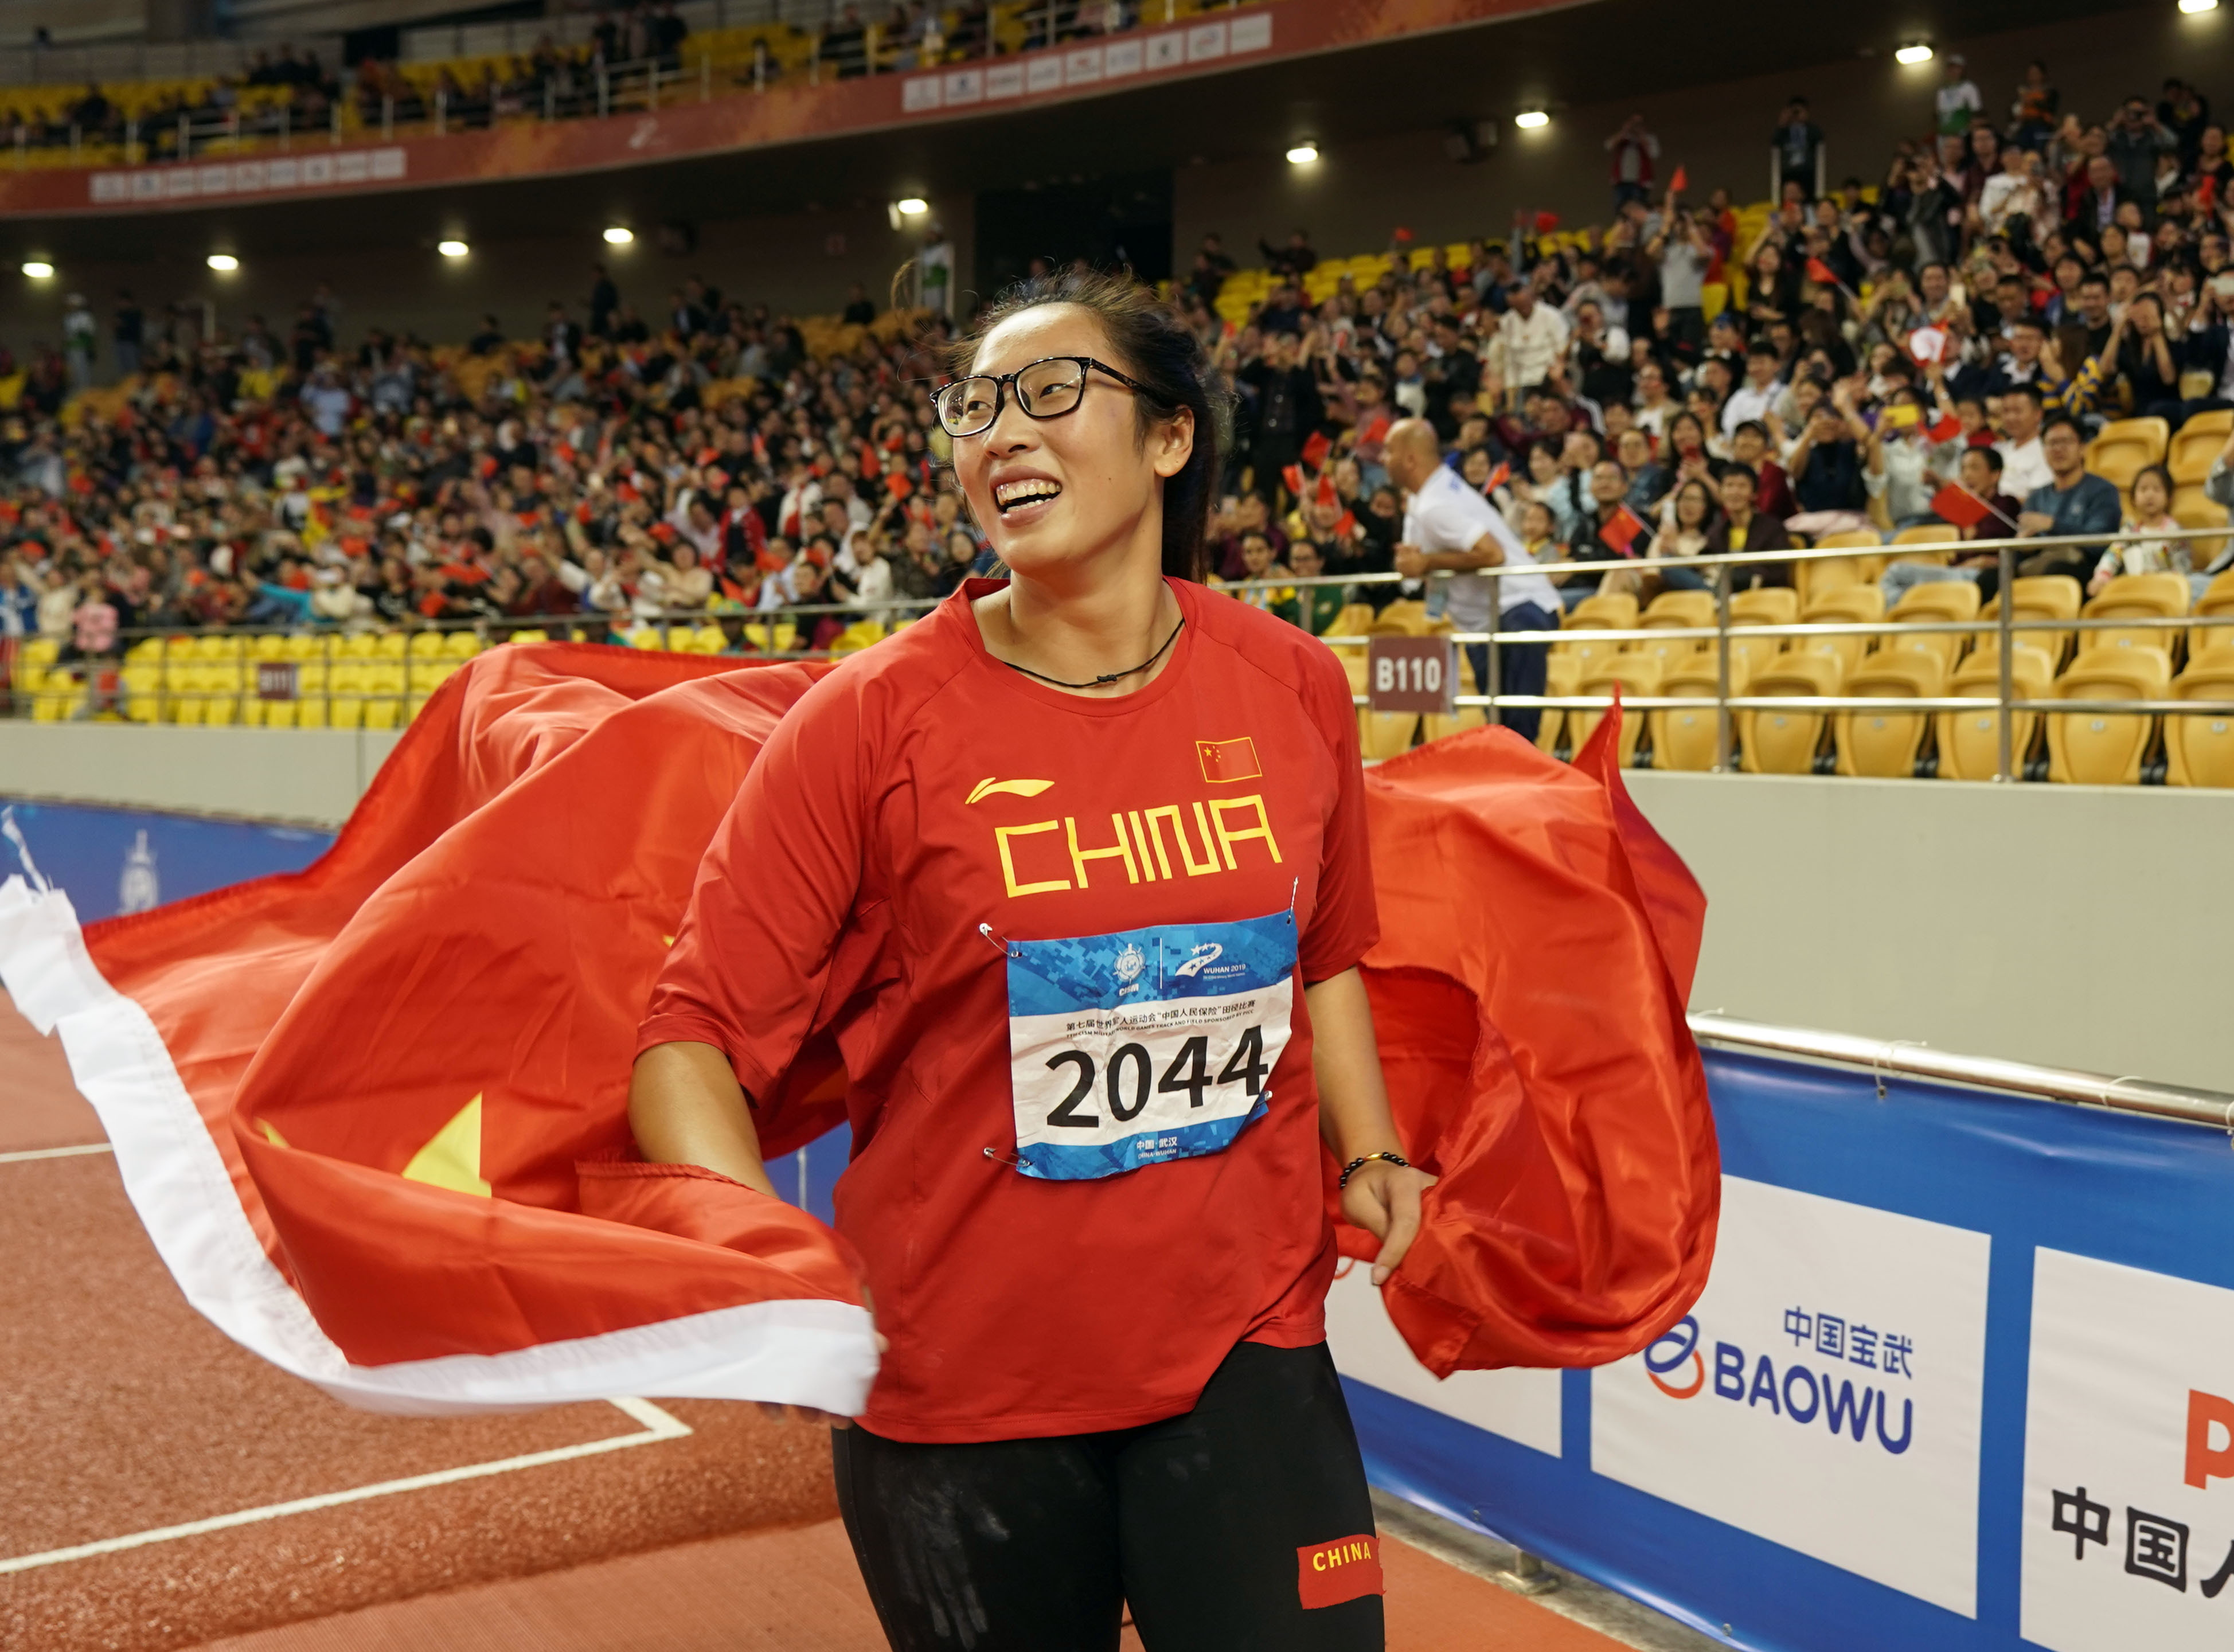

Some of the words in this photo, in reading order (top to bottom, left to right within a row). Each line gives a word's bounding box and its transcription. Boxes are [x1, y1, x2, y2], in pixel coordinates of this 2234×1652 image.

[1376, 657, 1441, 692] B110
[994, 794, 1283, 897] CHINA
[1231, 964, 1246, 972] 2019
[1119, 983, 1139, 996] CISM
[1204, 1014, 1235, 1024] SPONSORED
[1045, 1025, 1268, 1128] 2044
[1784, 1306, 1912, 1380] 中国宝武
[1716, 1340, 1912, 1454] BAOWU
[1313, 1542, 1372, 1572] CHINA
